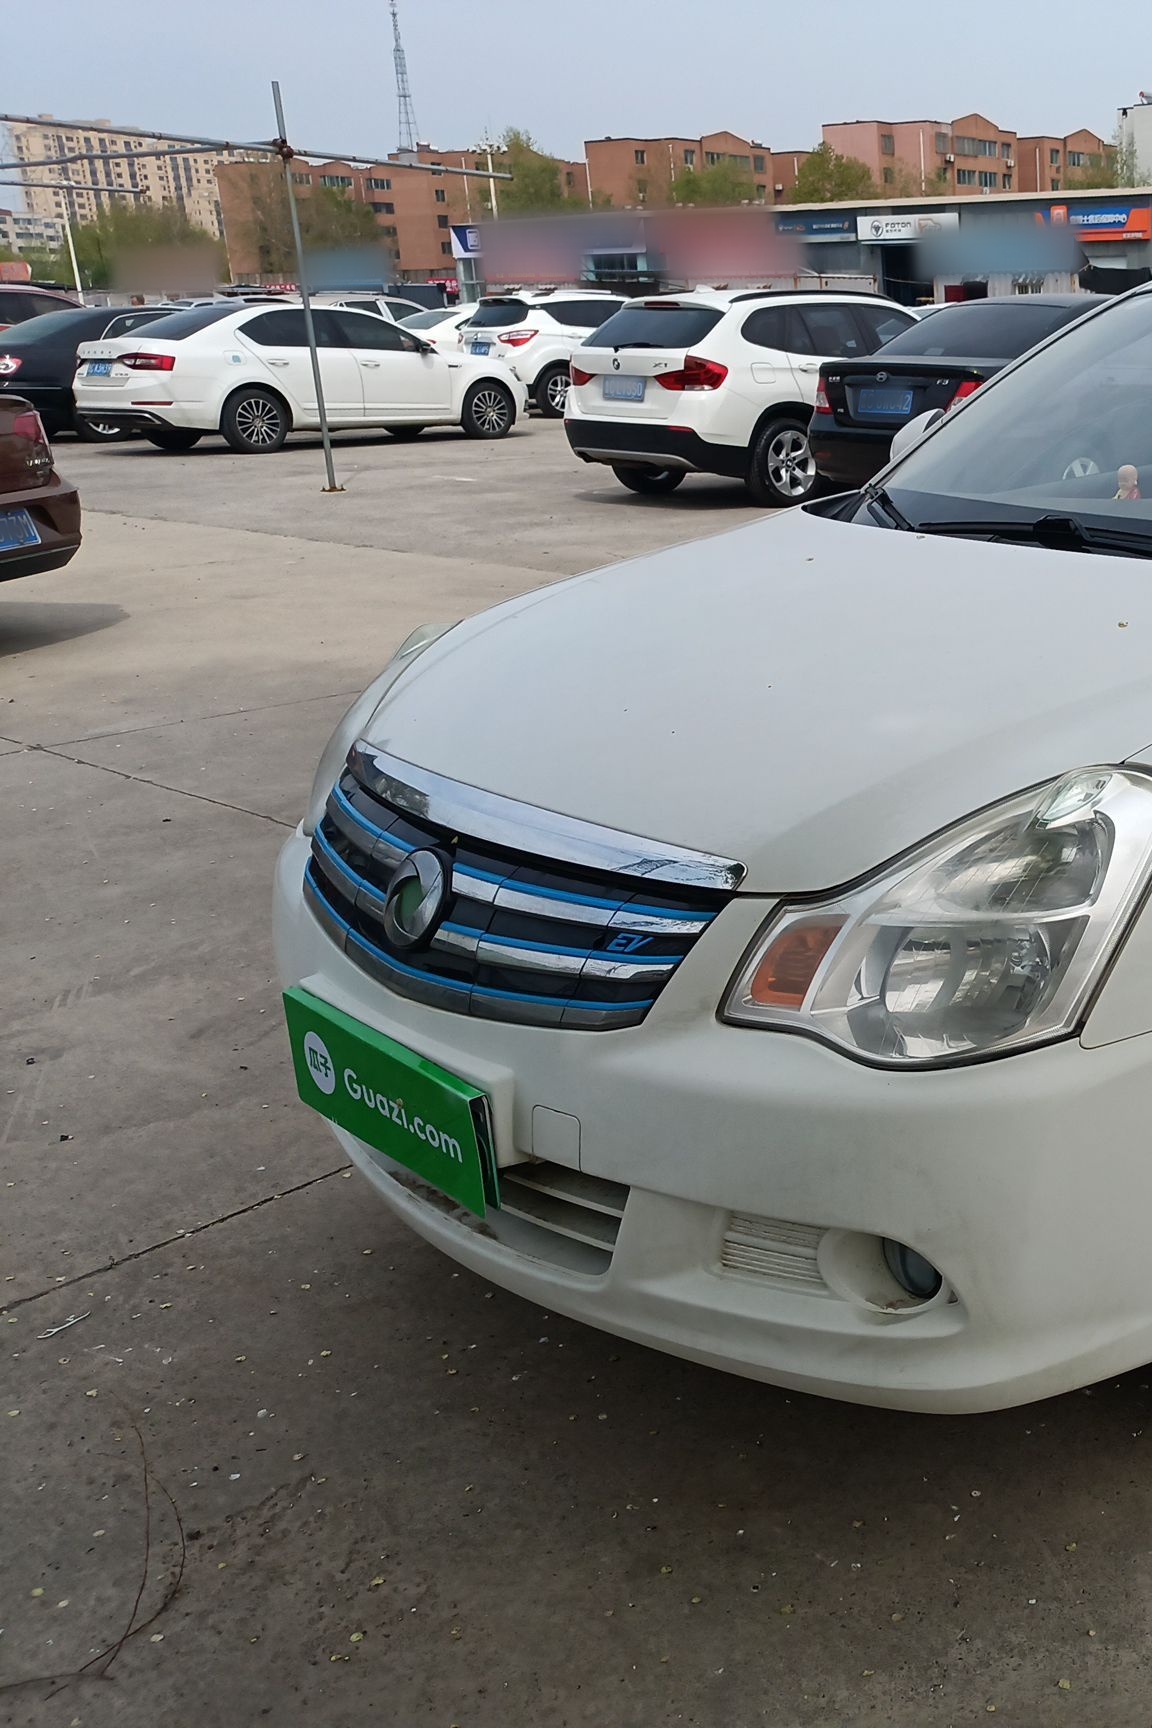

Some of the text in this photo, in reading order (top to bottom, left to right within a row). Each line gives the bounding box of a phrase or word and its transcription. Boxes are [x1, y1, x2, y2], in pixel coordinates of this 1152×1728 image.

[607, 933, 654, 952] EV
[308, 1046, 332, 1078] 瓜子
[343, 1067, 464, 1164] Guazi.com
